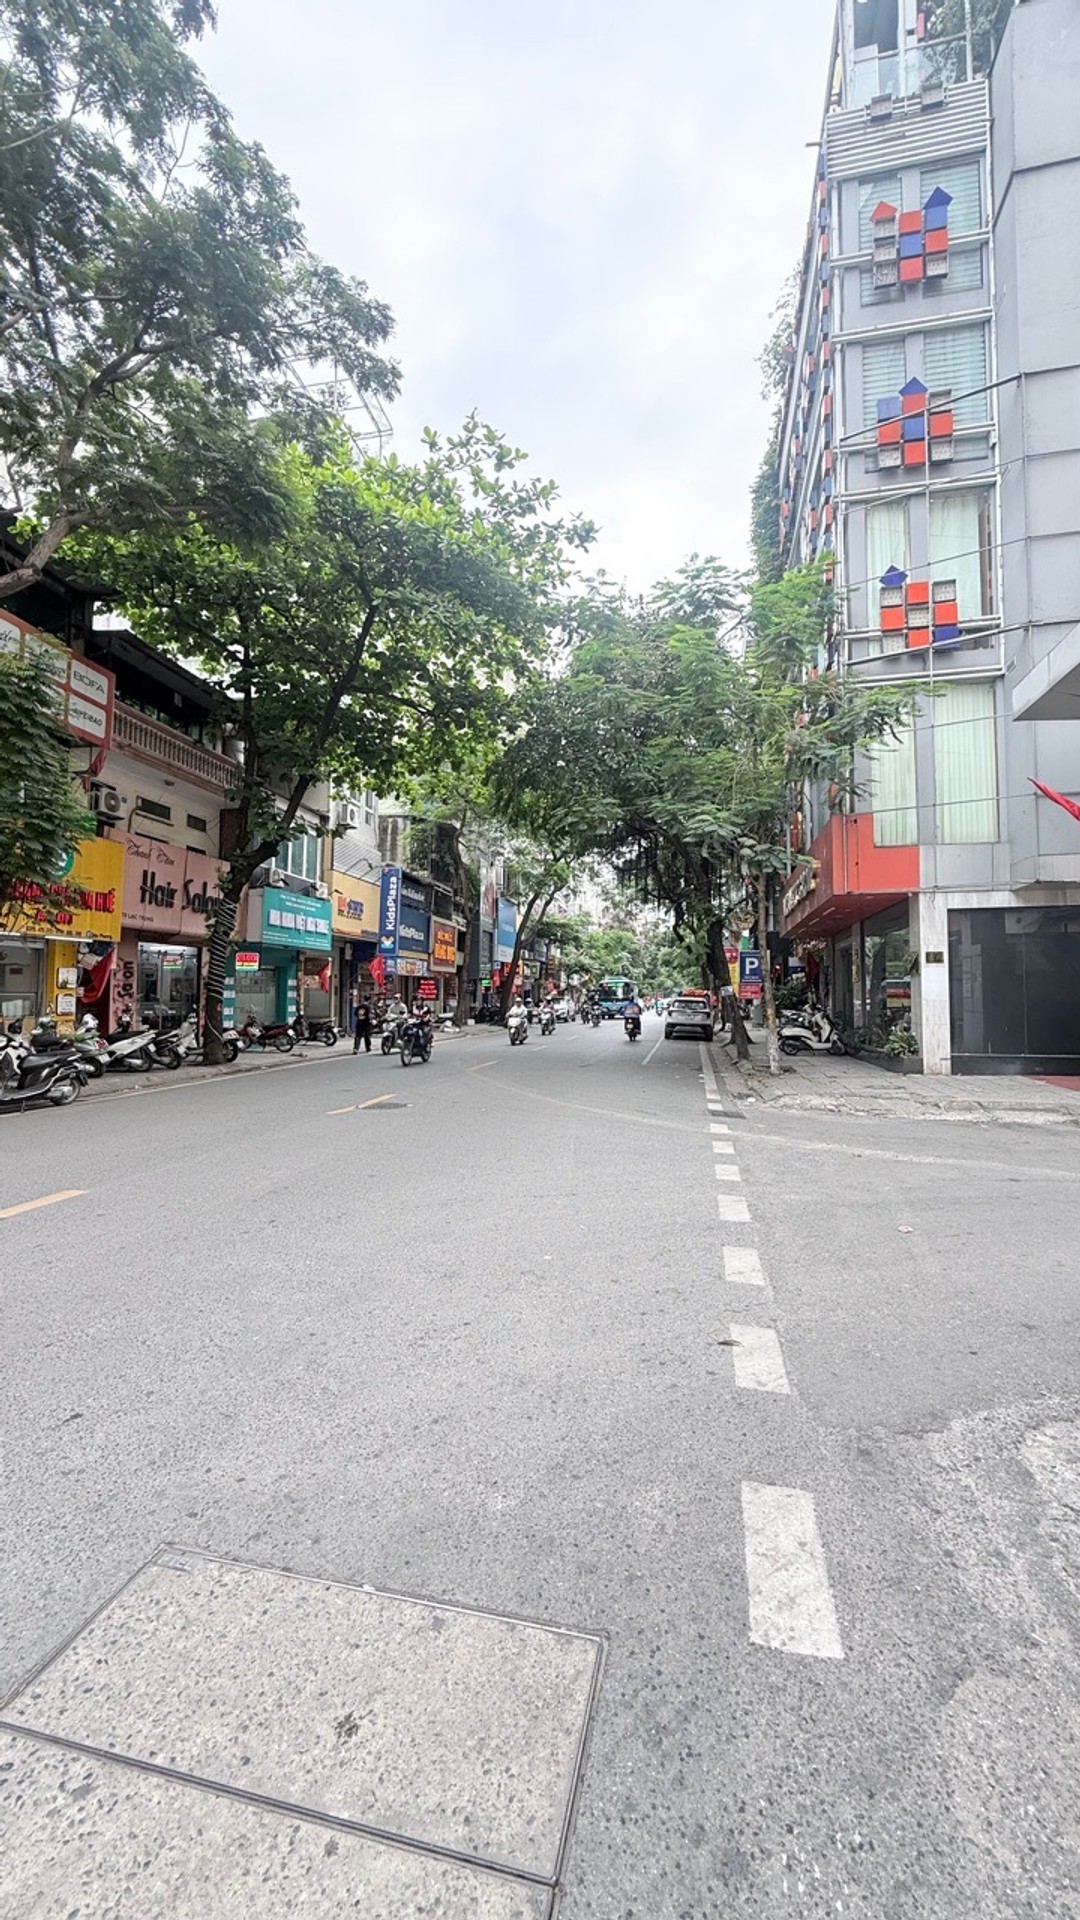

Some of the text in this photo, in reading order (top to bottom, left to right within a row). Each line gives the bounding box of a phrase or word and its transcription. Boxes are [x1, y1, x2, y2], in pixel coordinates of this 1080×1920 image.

[140, 869, 178, 908] Hair
[386, 876, 398, 930] KidsPlaza
[745, 957, 759, 975] P
